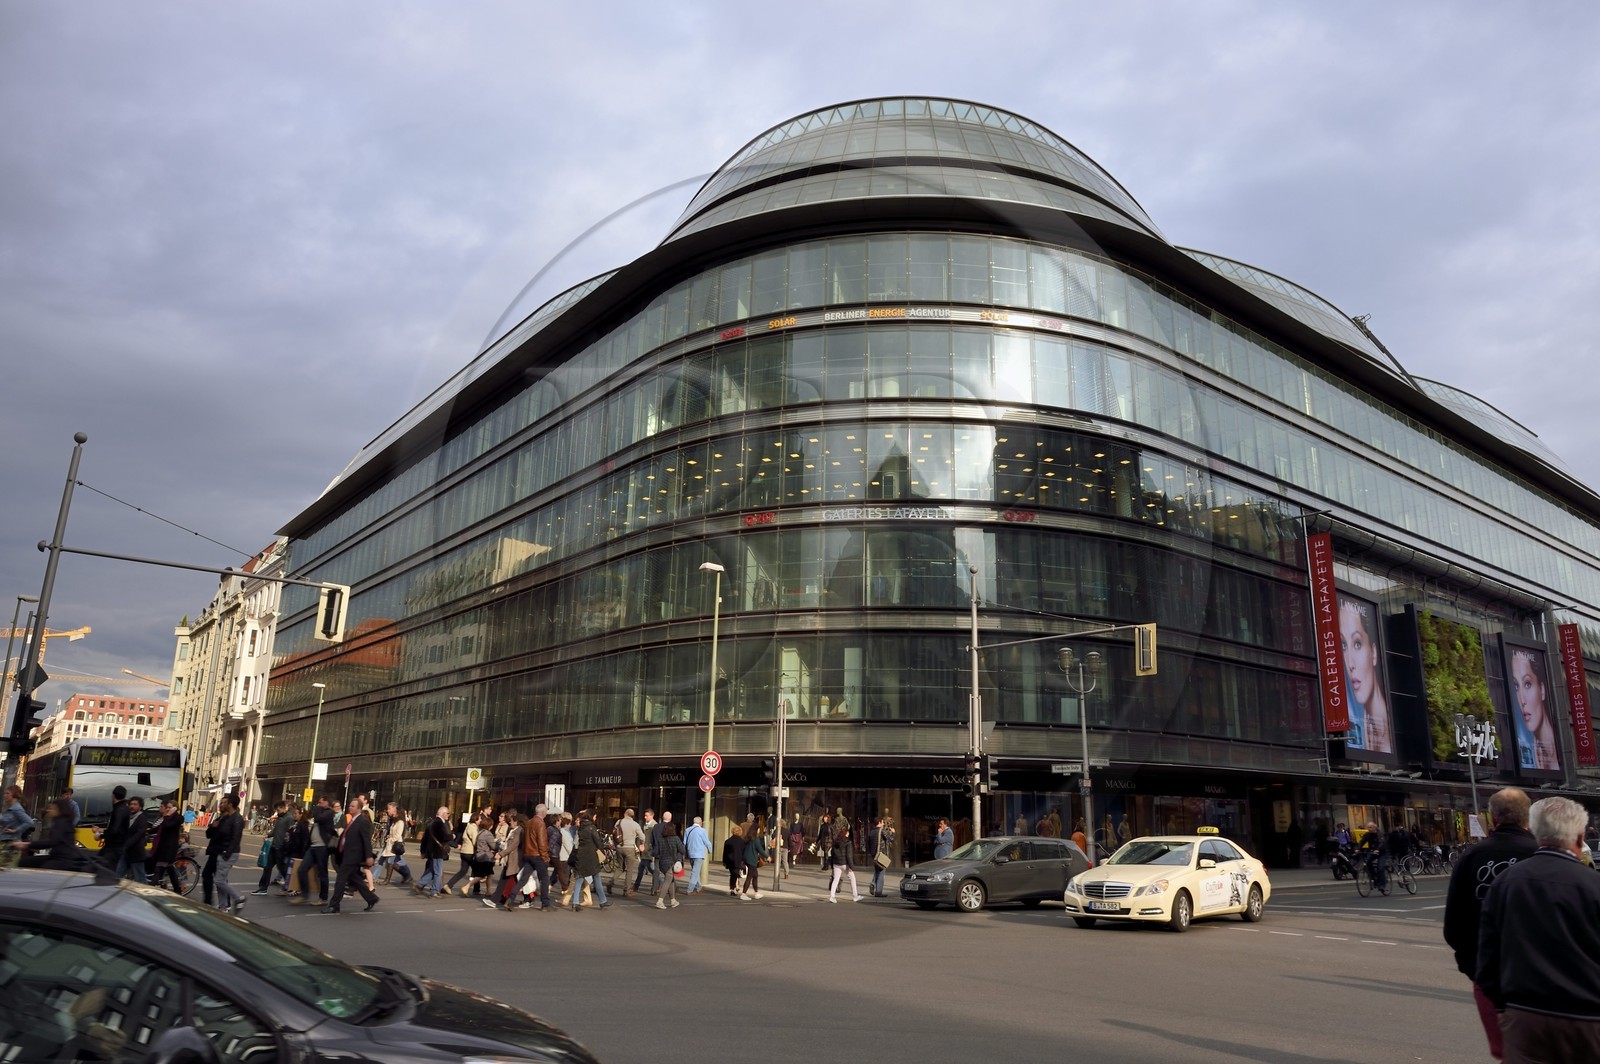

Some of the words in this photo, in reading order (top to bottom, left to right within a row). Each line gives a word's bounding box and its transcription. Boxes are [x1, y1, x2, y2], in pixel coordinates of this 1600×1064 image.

[825, 310, 866, 321] BERLINER
[868, 308, 906, 318] ENERGIE
[909, 308, 951, 317] AGENTUR
[769, 317, 797, 329] SOLAR
[822, 507, 882, 520] GALERIES
[1314, 540, 1333, 624] LAFAYETTE
[1564, 628, 1581, 688] LAFAYETTE
[1323, 631, 1341, 707] GALERIES
[1573, 693, 1590, 747] GALERIES
[705, 757, 718, 769] 30
[586, 777, 593, 785] LE
[595, 775, 622, 784] TANNEUR
